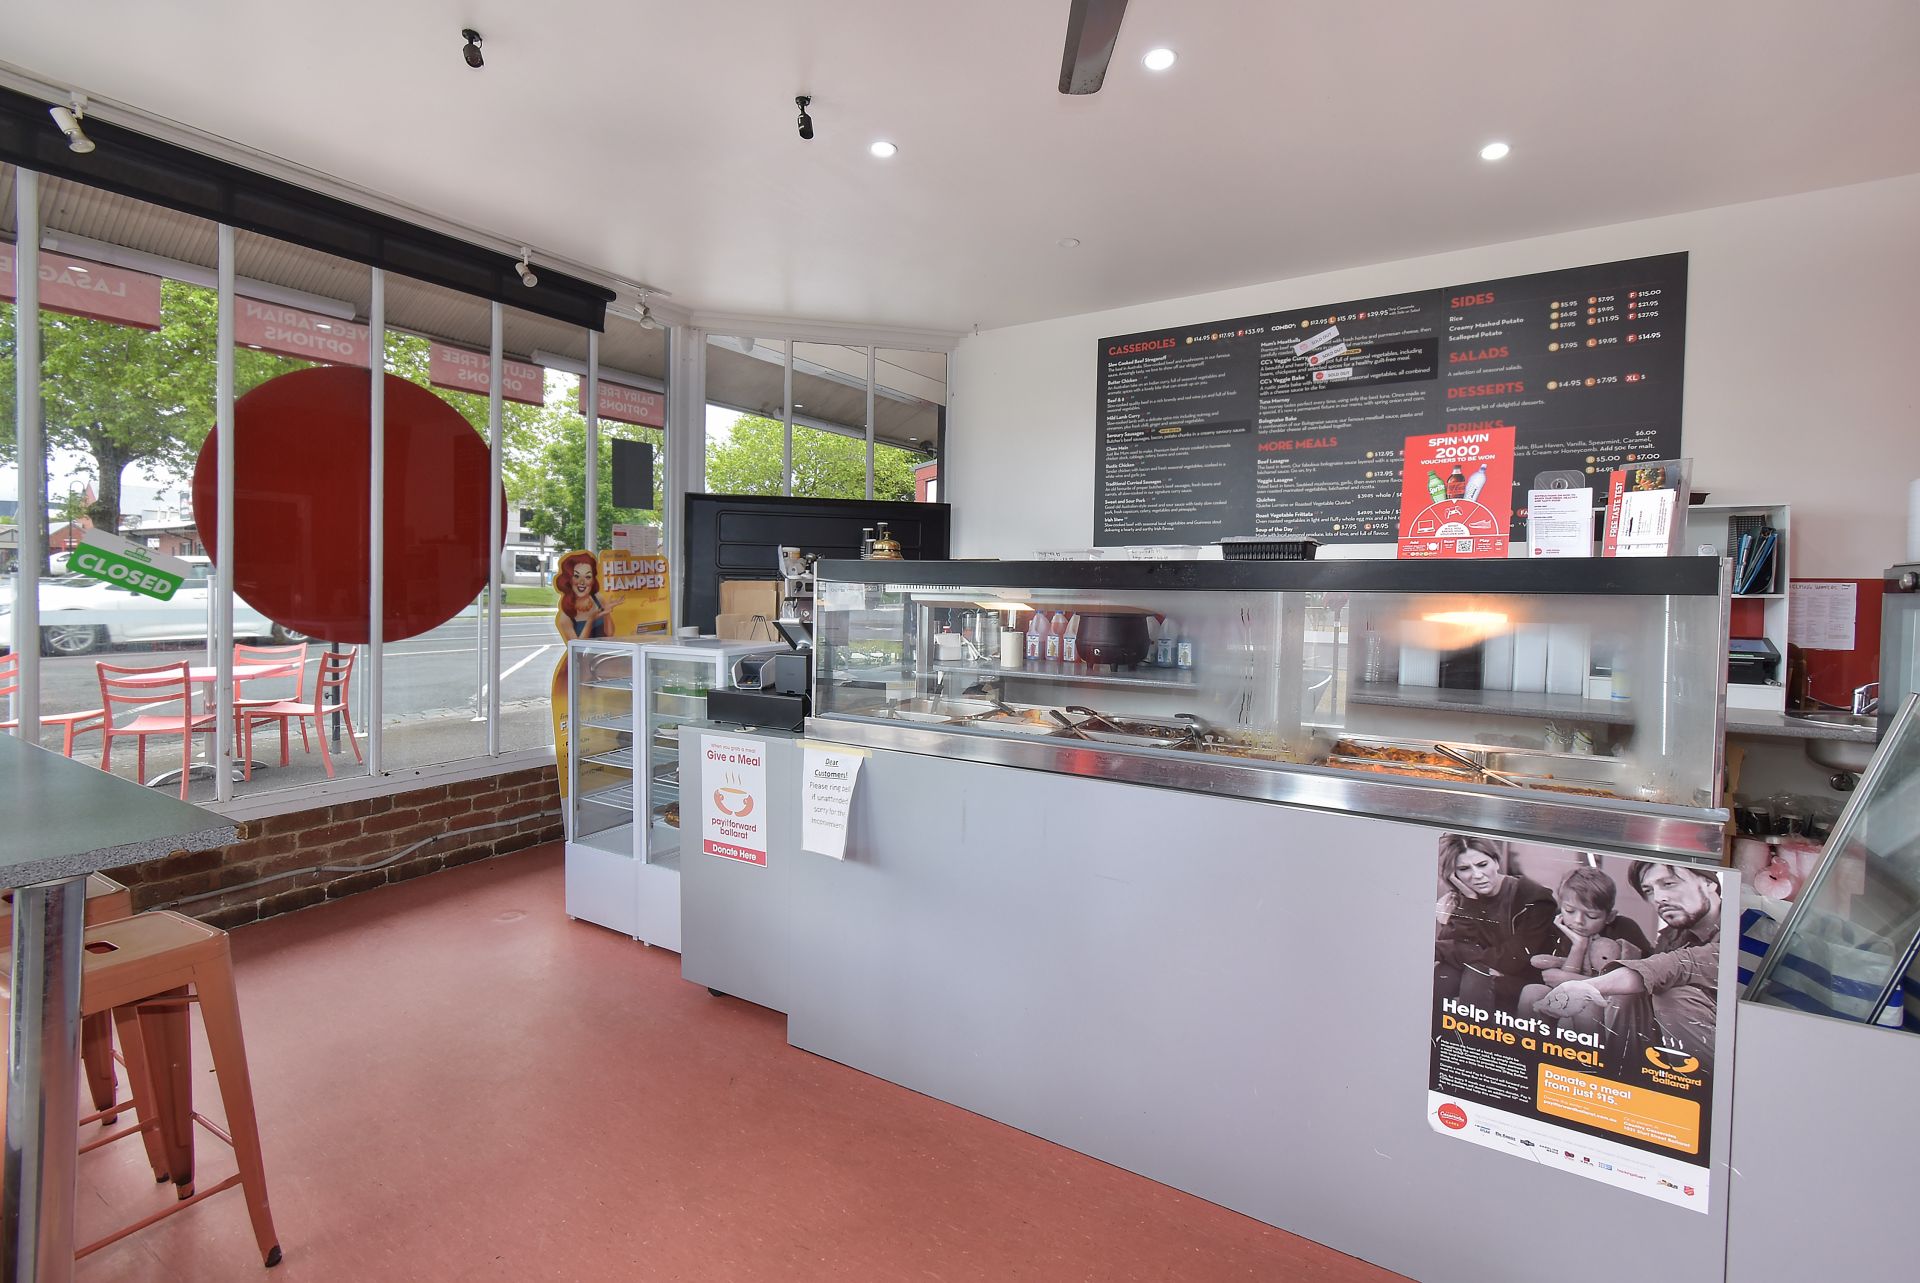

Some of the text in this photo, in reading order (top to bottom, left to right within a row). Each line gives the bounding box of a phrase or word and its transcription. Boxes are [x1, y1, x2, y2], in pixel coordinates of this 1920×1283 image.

[1451, 292, 1495, 309] SIDES
[1597, 295, 1615, 303] $7.95
[1638, 289, 1662, 297] $15.00
[1310, 309, 1389, 326] $12.95 $29.95
[1449, 324, 1474, 332] Creamy
[1475, 320, 1500, 328] Mashed
[1638, 300, 1659, 308] $21.95
[1449, 332, 1480, 341] Scalloped
[1480, 330, 1503, 338] Potato
[1597, 315, 1620, 323] $11.95
[1638, 311, 1659, 319] $27.95
[1312, 337, 1323, 345] SOLD
[1638, 332, 1662, 340] $14.95
[1108, 338, 1176, 356] CASSEROLES
[1334, 346, 1344, 354] OUT
[1273, 357, 1292, 365] Veggie
[1292, 355, 1308, 363] Curry
[1449, 346, 1510, 363] SALADS
[1273, 376, 1291, 384] Veggie
[1558, 374, 1639, 388] $4.95 $7.95 XL
[1447, 381, 1524, 399] DESSERTS
[1496, 401, 1521, 409] delightful
[1258, 437, 1338, 452] MORE MEALS
[1544, 442, 1565, 450] Haven,
[1589, 439, 1622, 447] Spearmint,
[1435, 445, 1480, 459] 2000
[1478, 454, 1496, 462] WON
[1596, 453, 1661, 463] $5.00 $7.00
[1269, 458, 1290, 466] Lasagne
[1256, 477, 1294, 486] Veggie Lasagne
[1270, 511, 1294, 519] Vegetable
[1610, 482, 1623, 538] FREE TASTE TEST
[1372, 522, 1389, 530] $9.95
[78, 553, 172, 594] CLOSED
[603, 559, 666, 576] HELPING
[604, 575, 665, 592] HAMPER
[707, 750, 761, 767] Give a Meal
[825, 758, 839, 767] Dear
[814, 769, 848, 779] Customers!
[809, 781, 841, 793] Please ring
[817, 795, 849, 805] unattended
[813, 806, 837, 816] sorry for
[711, 817, 757, 833] payitforward
[720, 827, 748, 840] ballarat
[712, 844, 757, 861] Donate Here
[1442, 997, 1605, 1050] Help that's real.
[1442, 1013, 1605, 1067] Donate a meal.
[1544, 1070, 1631, 1100] Donate a meal
[1652, 1075, 1690, 1090] ballarat
[1544, 1079, 1619, 1105] from just $15.
